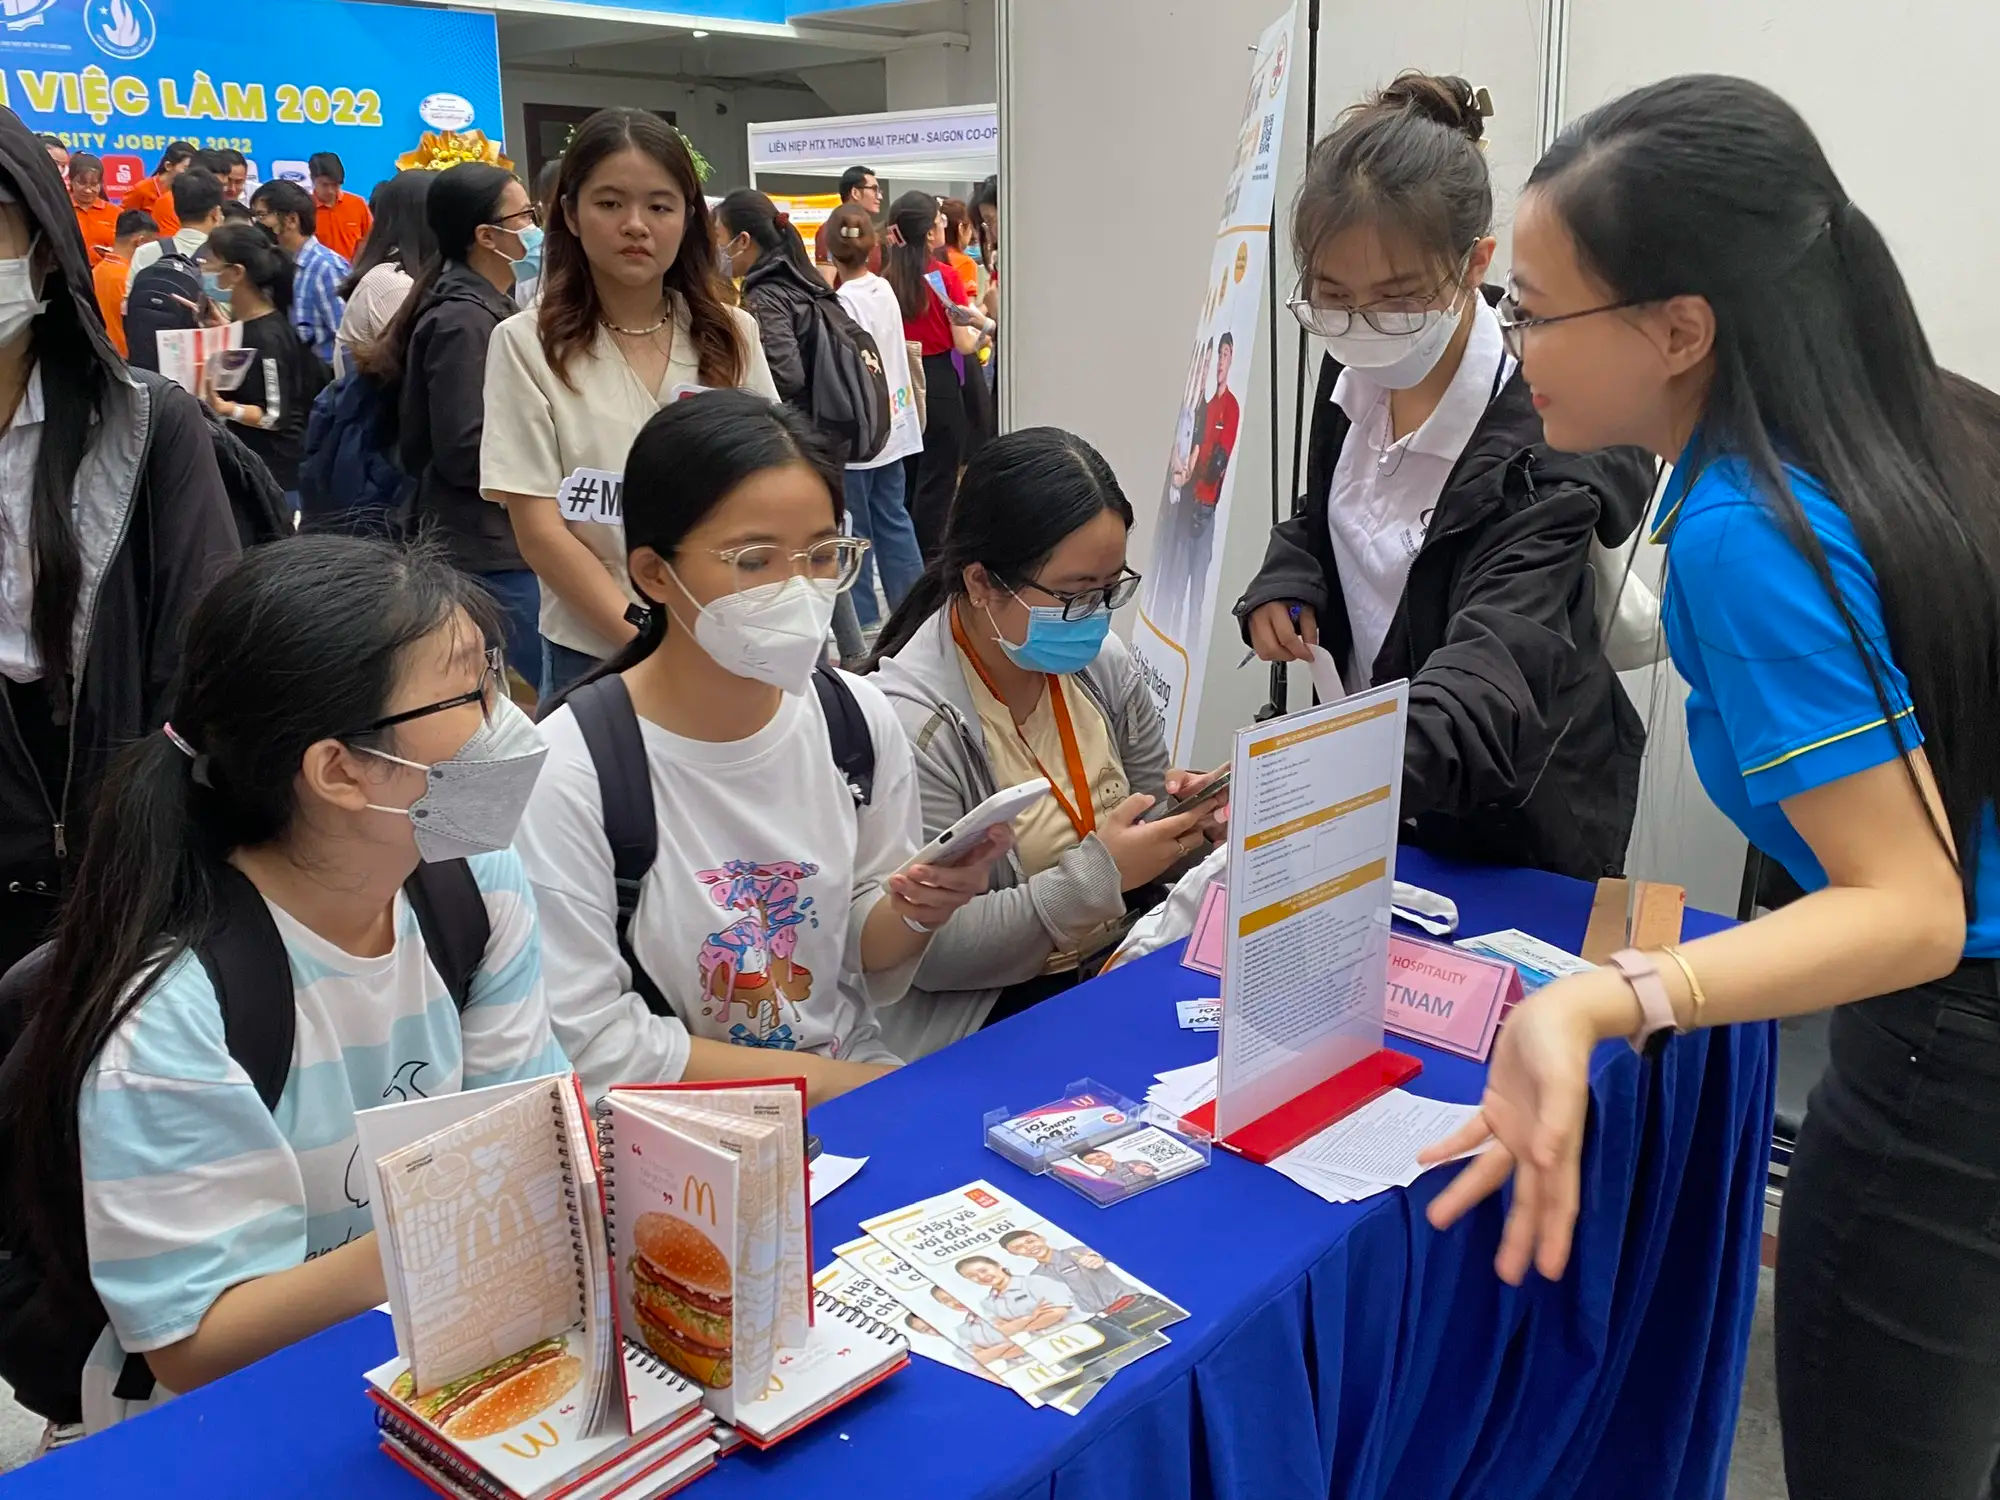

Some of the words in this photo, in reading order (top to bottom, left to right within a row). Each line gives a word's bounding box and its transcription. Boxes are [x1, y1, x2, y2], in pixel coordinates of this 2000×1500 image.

[16, 64, 150, 126] VIỆC
[159, 69, 268, 122] LÀM
[275, 84, 383, 127] 2022
[768, 140, 787, 153] LIÊN
[789, 140, 808, 154] HIỆP
[809, 139, 826, 151] HTX
[867, 135, 884, 149] MẠI
[886, 133, 919, 146] TP.HCM
[926, 130, 963, 143] SAIGON
[965, 127, 998, 141] CO-OP
[1392, 956, 1467, 985] HOSPITALITY
[1387, 982, 1454, 1018] TNAM
[916, 1218, 954, 1236] Hãy
[953, 1209, 977, 1222] về
[913, 1235, 943, 1251] với
[944, 1224, 973, 1240] đội
[933, 1232, 992, 1257] chúng
[988, 1219, 1016, 1235] tôi
[886, 1261, 912, 1275] vớ
[842, 1278, 872, 1296] Hã
